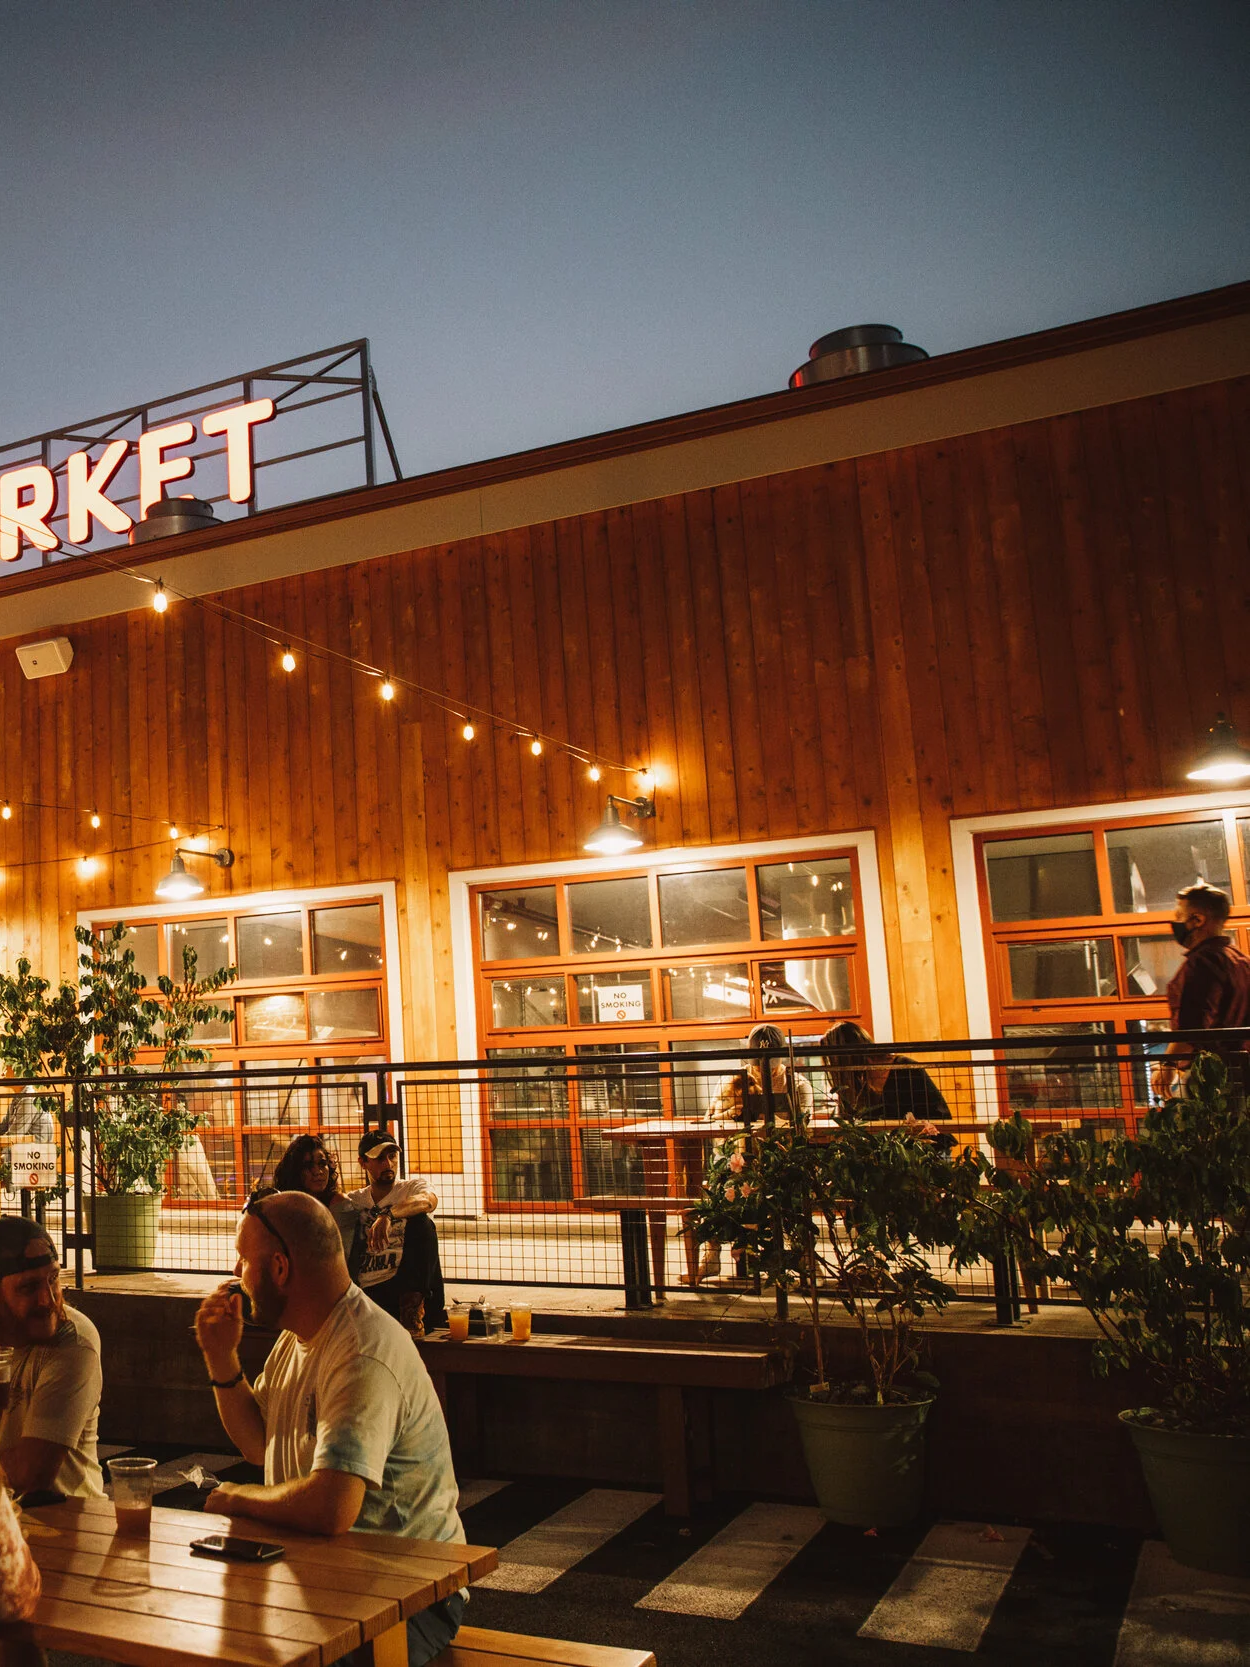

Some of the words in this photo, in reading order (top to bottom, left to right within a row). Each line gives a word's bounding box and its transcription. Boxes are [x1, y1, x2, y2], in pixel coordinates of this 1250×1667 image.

[600, 1000, 641, 1009] SMOKING
[27, 1151, 41, 1160] NO
[13, 1162, 55, 1171] SMOKING
